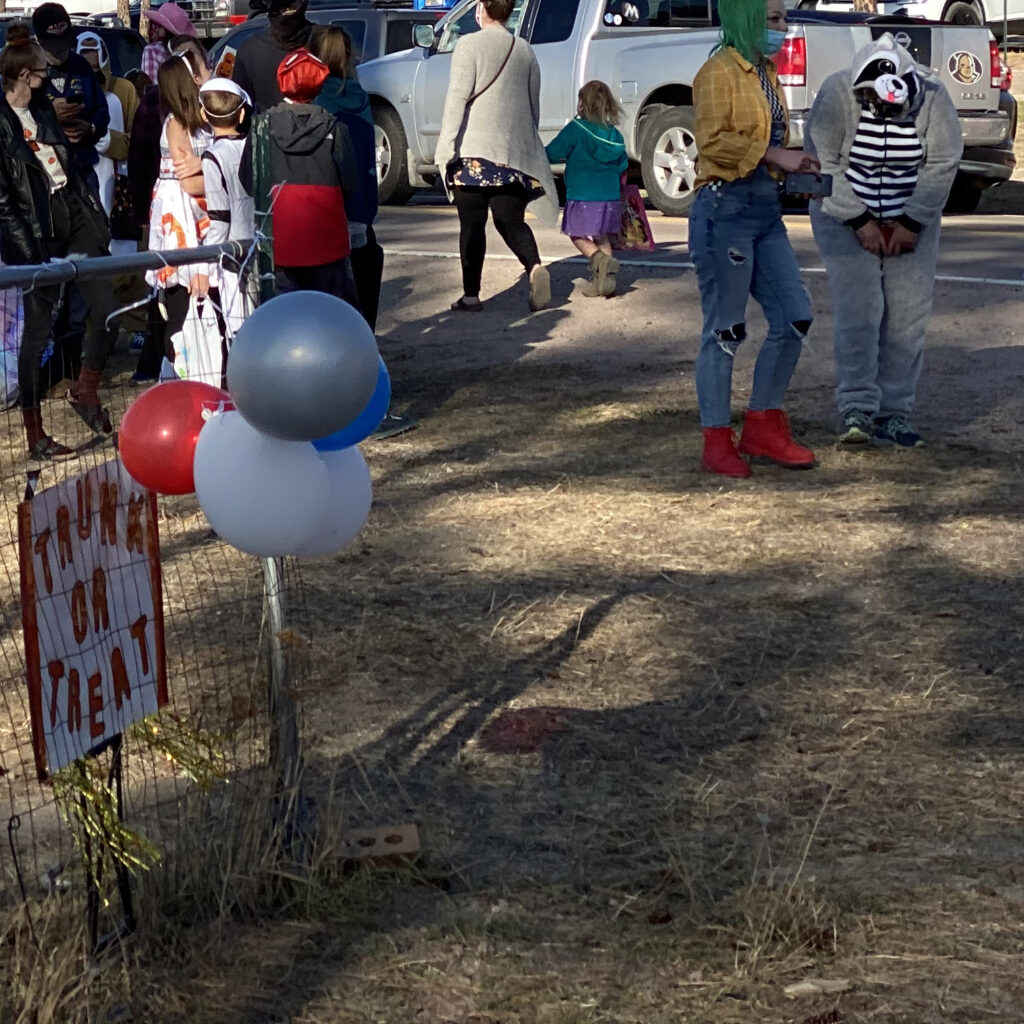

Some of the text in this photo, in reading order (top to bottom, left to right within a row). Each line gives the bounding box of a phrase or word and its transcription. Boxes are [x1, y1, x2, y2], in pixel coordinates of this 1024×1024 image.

[34, 477, 145, 594] TRUNK
[70, 567, 110, 644] OR
[48, 613, 149, 739] TREAT
